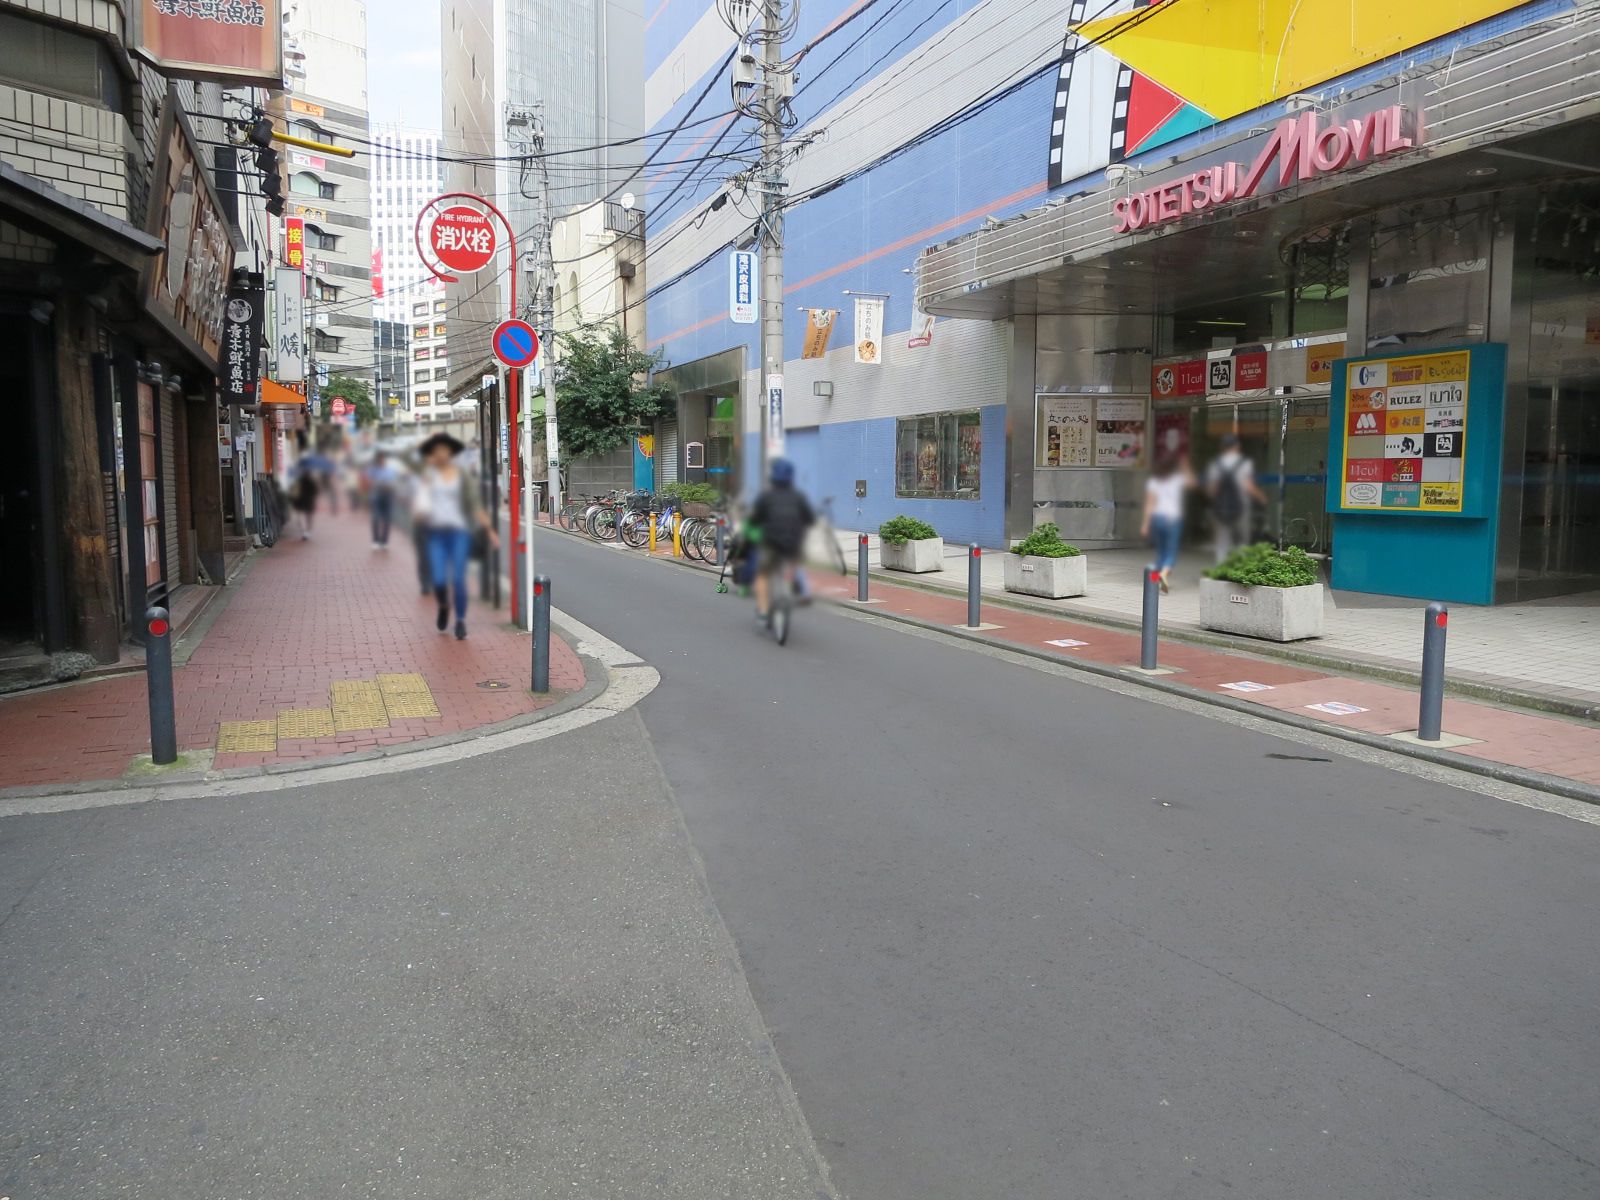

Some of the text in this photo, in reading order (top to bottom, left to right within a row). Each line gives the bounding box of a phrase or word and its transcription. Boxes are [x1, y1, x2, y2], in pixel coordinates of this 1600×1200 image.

[155, 0, 264, 25] 青木鮮魚店
[1113, 105, 1412, 233] SOTETSU MOVIL
[441, 213, 485, 223] FIRE HYDRANT
[288, 227, 303, 266] 接骨
[436, 225, 491, 253] 消火栓
[227, 323, 245, 394] 青木鮮魚店
[1181, 373, 1204, 385] 11cut
[1213, 366, 1229, 383] 牛角
[1390, 396, 1422, 406] RULEZ
